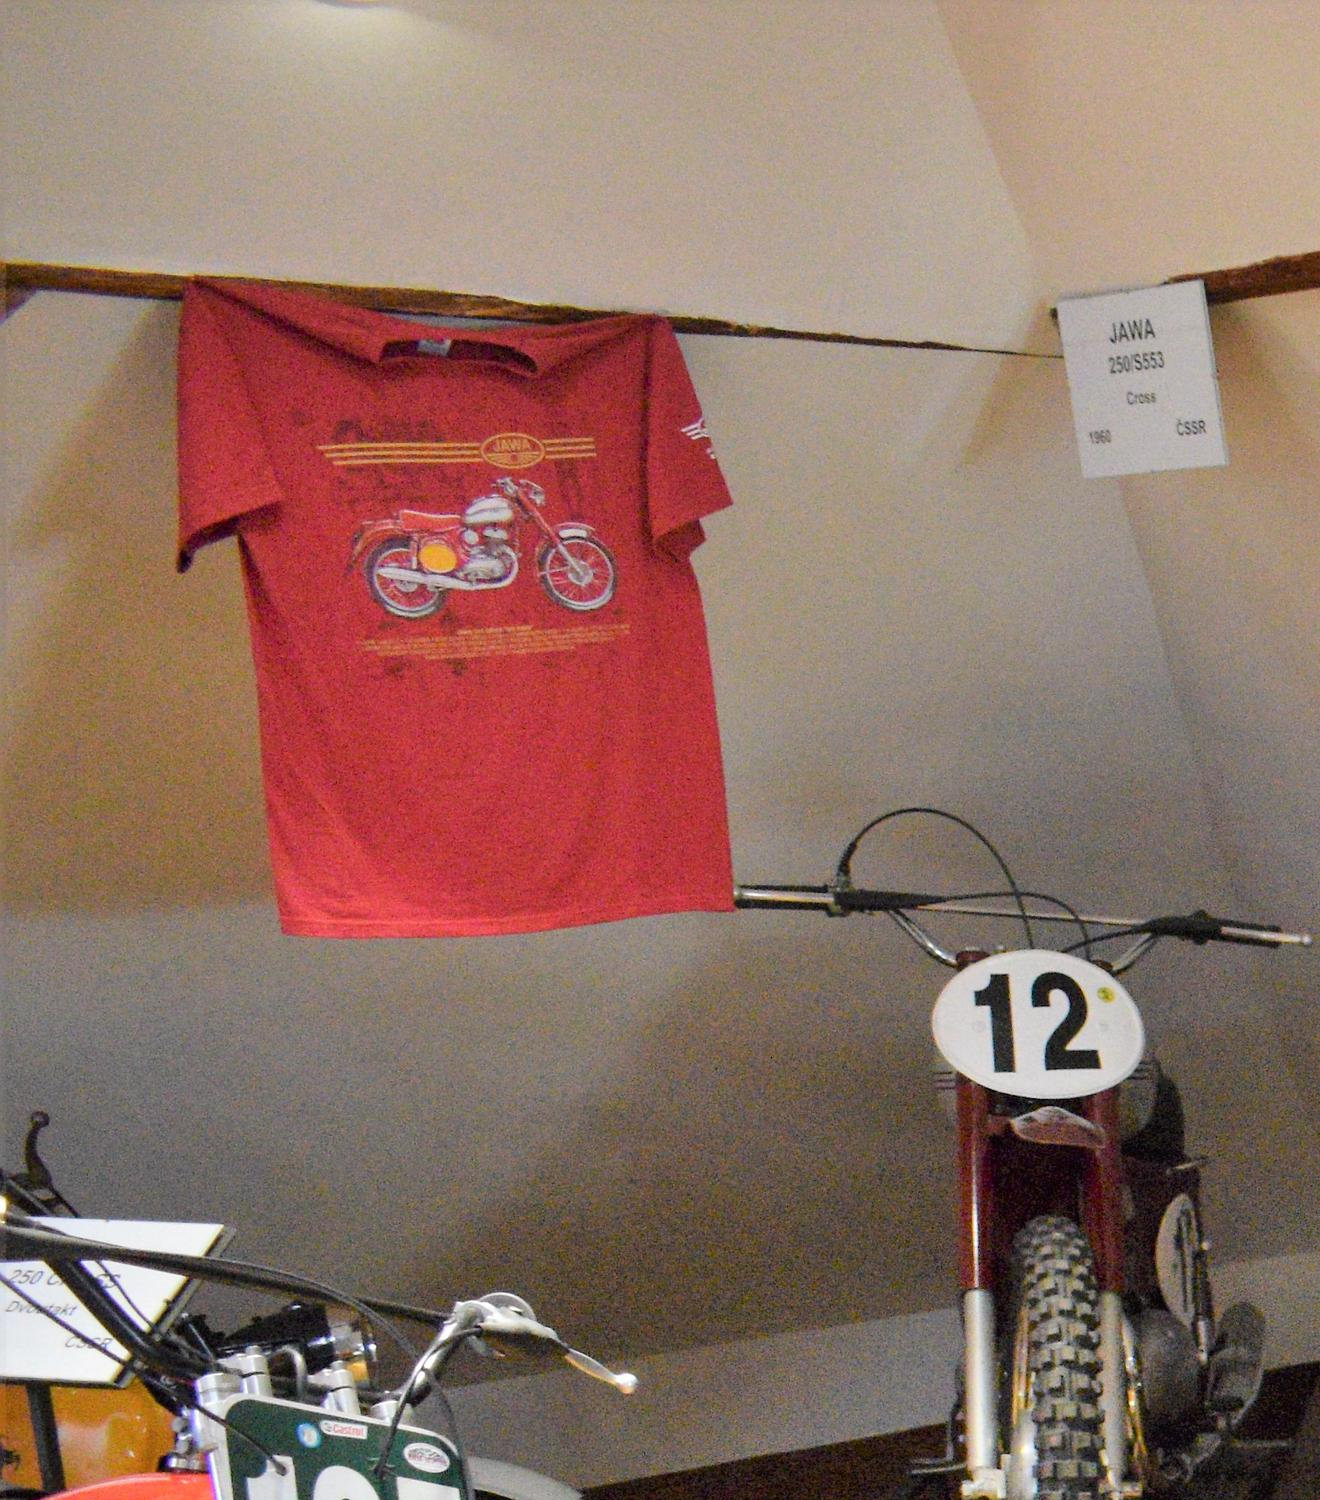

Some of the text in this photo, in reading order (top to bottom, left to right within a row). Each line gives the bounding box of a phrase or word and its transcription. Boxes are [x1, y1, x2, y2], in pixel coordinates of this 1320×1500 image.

[1109, 318, 1156, 344] JAWA
[1108, 351, 1166, 374] 250/S553
[1126, 391, 1157, 405] Cross
[1176, 418, 1207, 437] ČSSR
[973, 971, 1102, 1073] 12
[8, 1269, 44, 1285] 250
